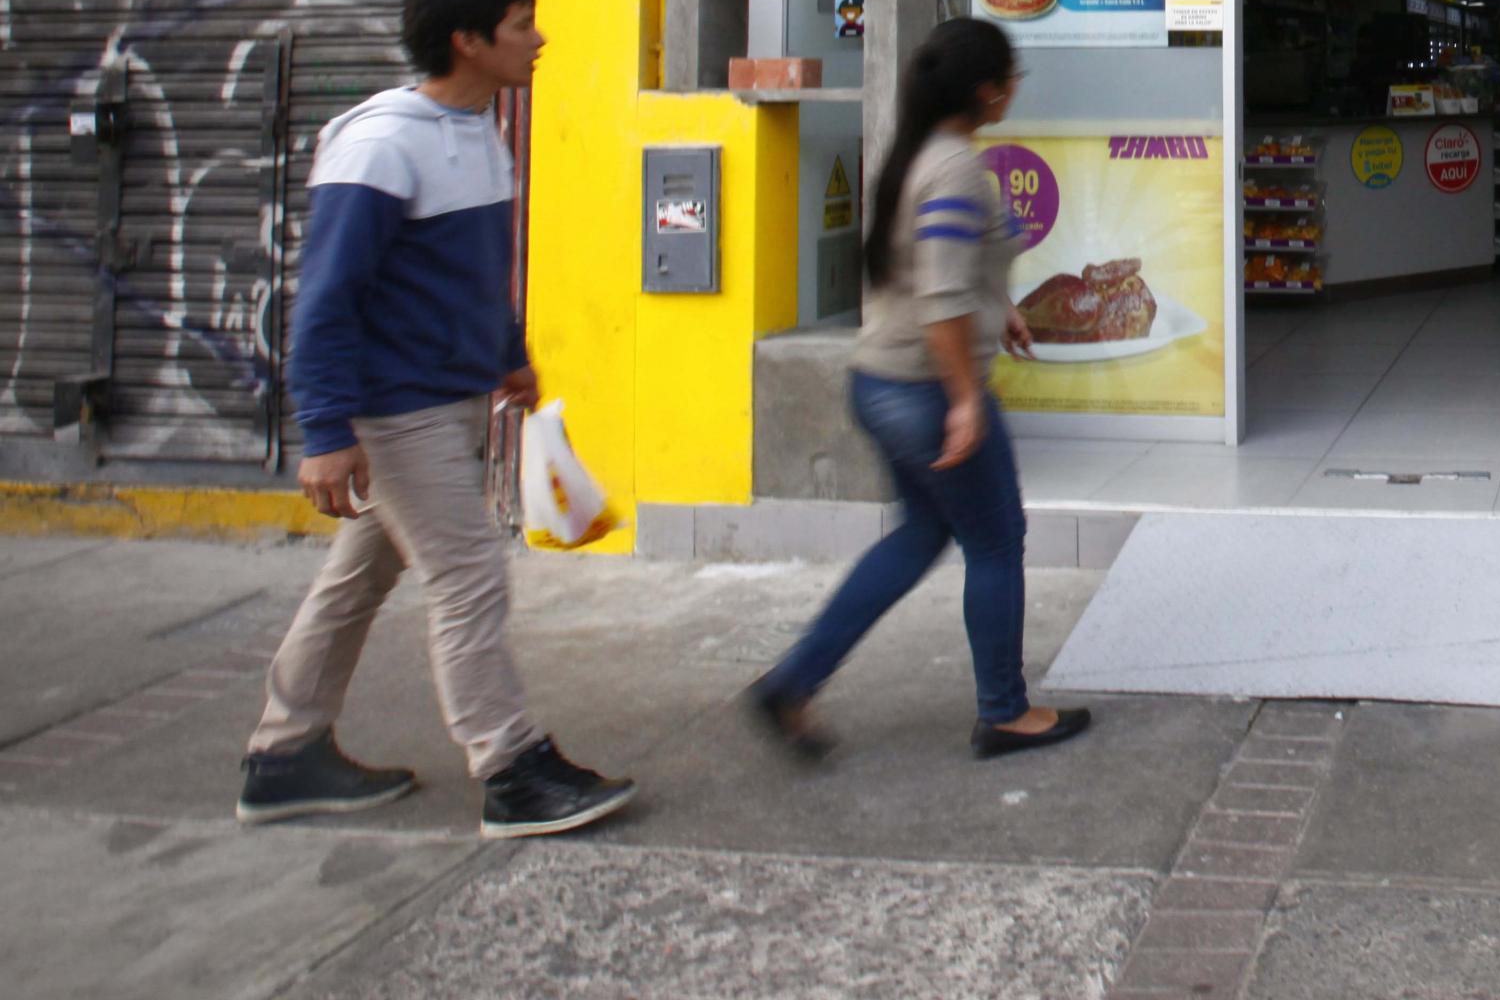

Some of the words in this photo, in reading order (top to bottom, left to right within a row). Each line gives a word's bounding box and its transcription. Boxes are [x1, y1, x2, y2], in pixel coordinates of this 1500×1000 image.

[1434, 137, 1464, 150] Claro
[1440, 150, 1470, 160] recarga
[1009, 168, 1039, 196] 90
